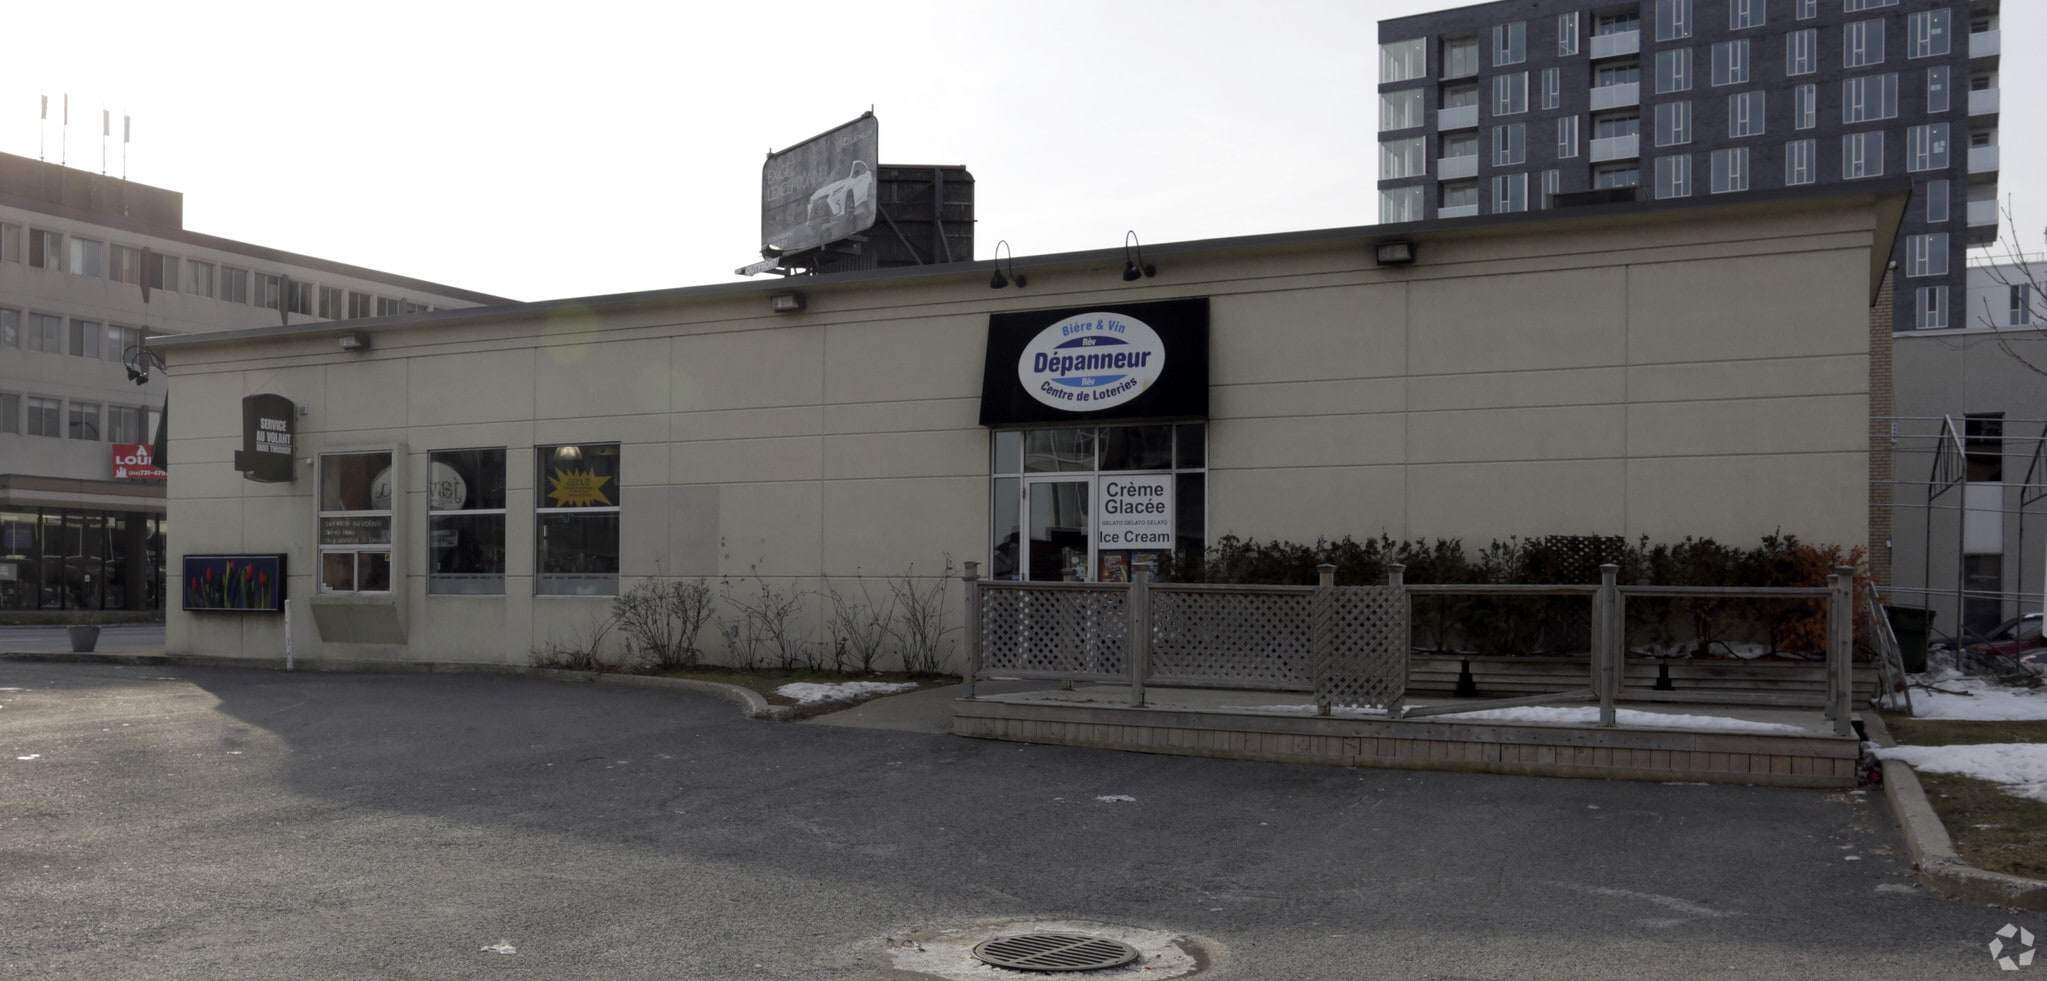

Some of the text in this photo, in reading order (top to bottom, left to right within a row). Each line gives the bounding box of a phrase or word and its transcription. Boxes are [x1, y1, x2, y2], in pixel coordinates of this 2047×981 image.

[1062, 319, 1126, 337] Bière & Vin
[1034, 349, 1152, 377] Dépanneur
[1040, 377, 1138, 402] Centre de Loteries
[260, 418, 287, 431] SERVICE
[256, 431, 291, 444] AU VOLANT
[136, 444, 147, 456] À
[115, 456, 152, 465] LOU
[1106, 481, 1164, 498] Crème
[1105, 498, 1166, 515] Glacée
[1099, 530, 1170, 543] Ice Cream
